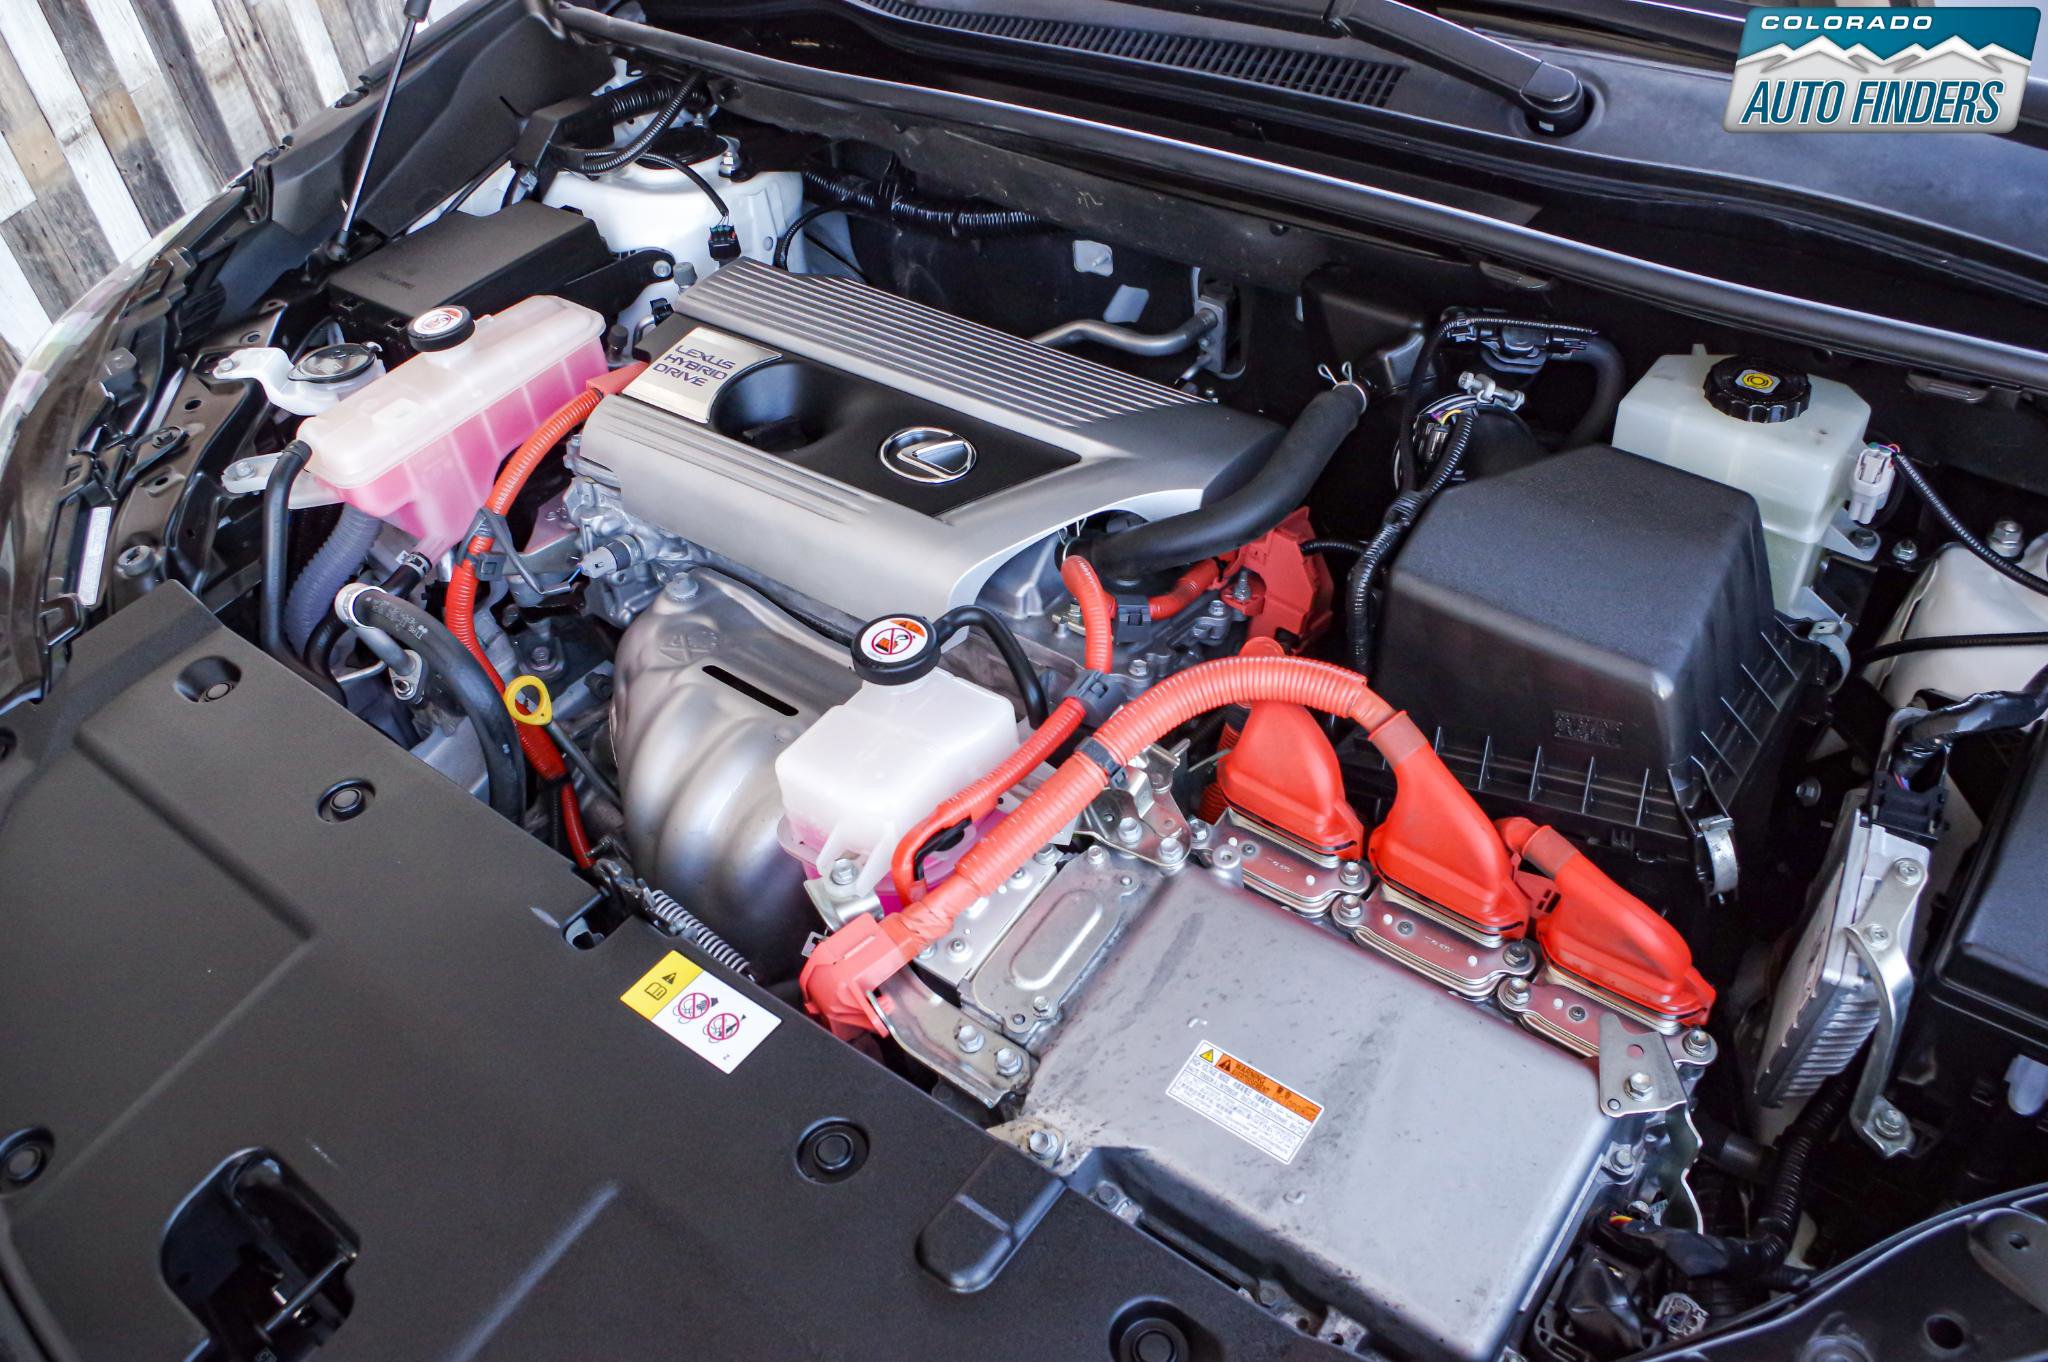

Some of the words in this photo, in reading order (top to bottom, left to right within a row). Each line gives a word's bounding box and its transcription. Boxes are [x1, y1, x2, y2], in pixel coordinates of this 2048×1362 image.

[664, 353, 728, 379] HYBRID
[675, 345, 736, 370] LEXUS
[653, 363, 709, 387] DRIVE
